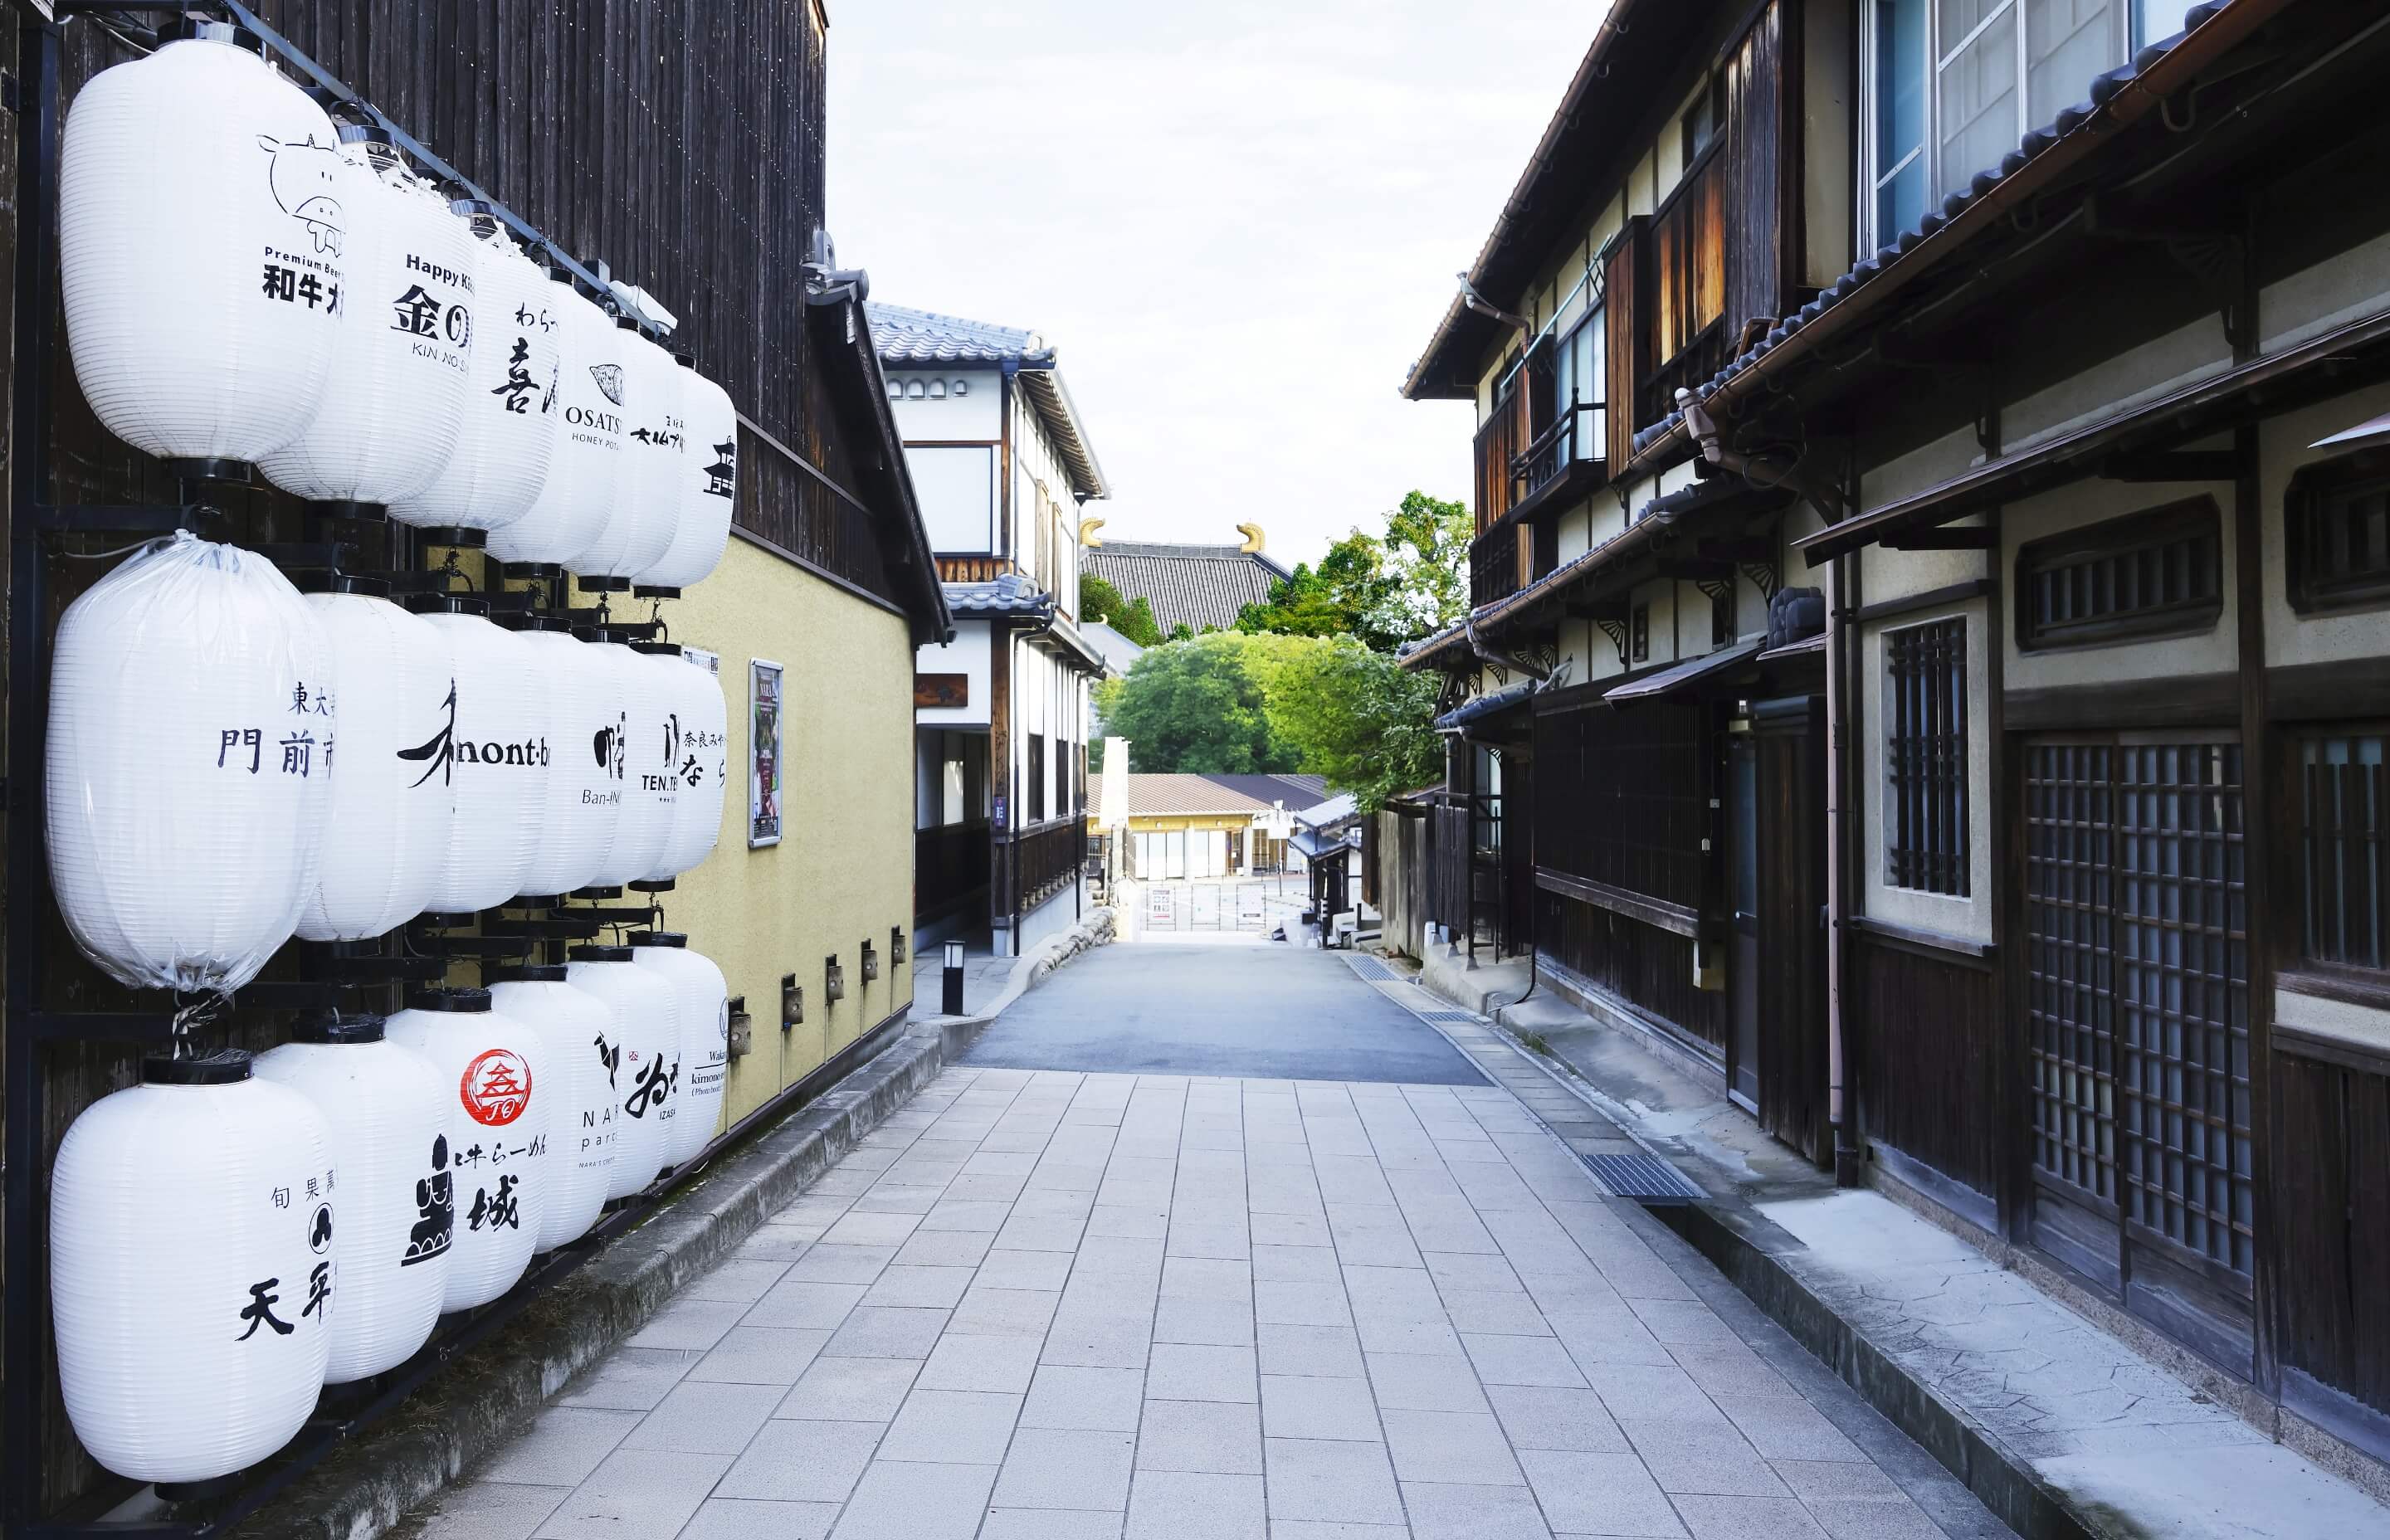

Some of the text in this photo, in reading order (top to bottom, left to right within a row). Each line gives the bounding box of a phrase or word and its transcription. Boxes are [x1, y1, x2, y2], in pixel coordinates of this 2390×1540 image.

[265, 246, 322, 270] Premium
[406, 254, 459, 287] Happy
[390, 284, 473, 353] 金の
[515, 301, 558, 334] わら
[412, 342, 437, 360] KIN
[565, 407, 622, 434] OSATS
[572, 433, 603, 446] HONEY
[691, 1074, 720, 1084] kimono
